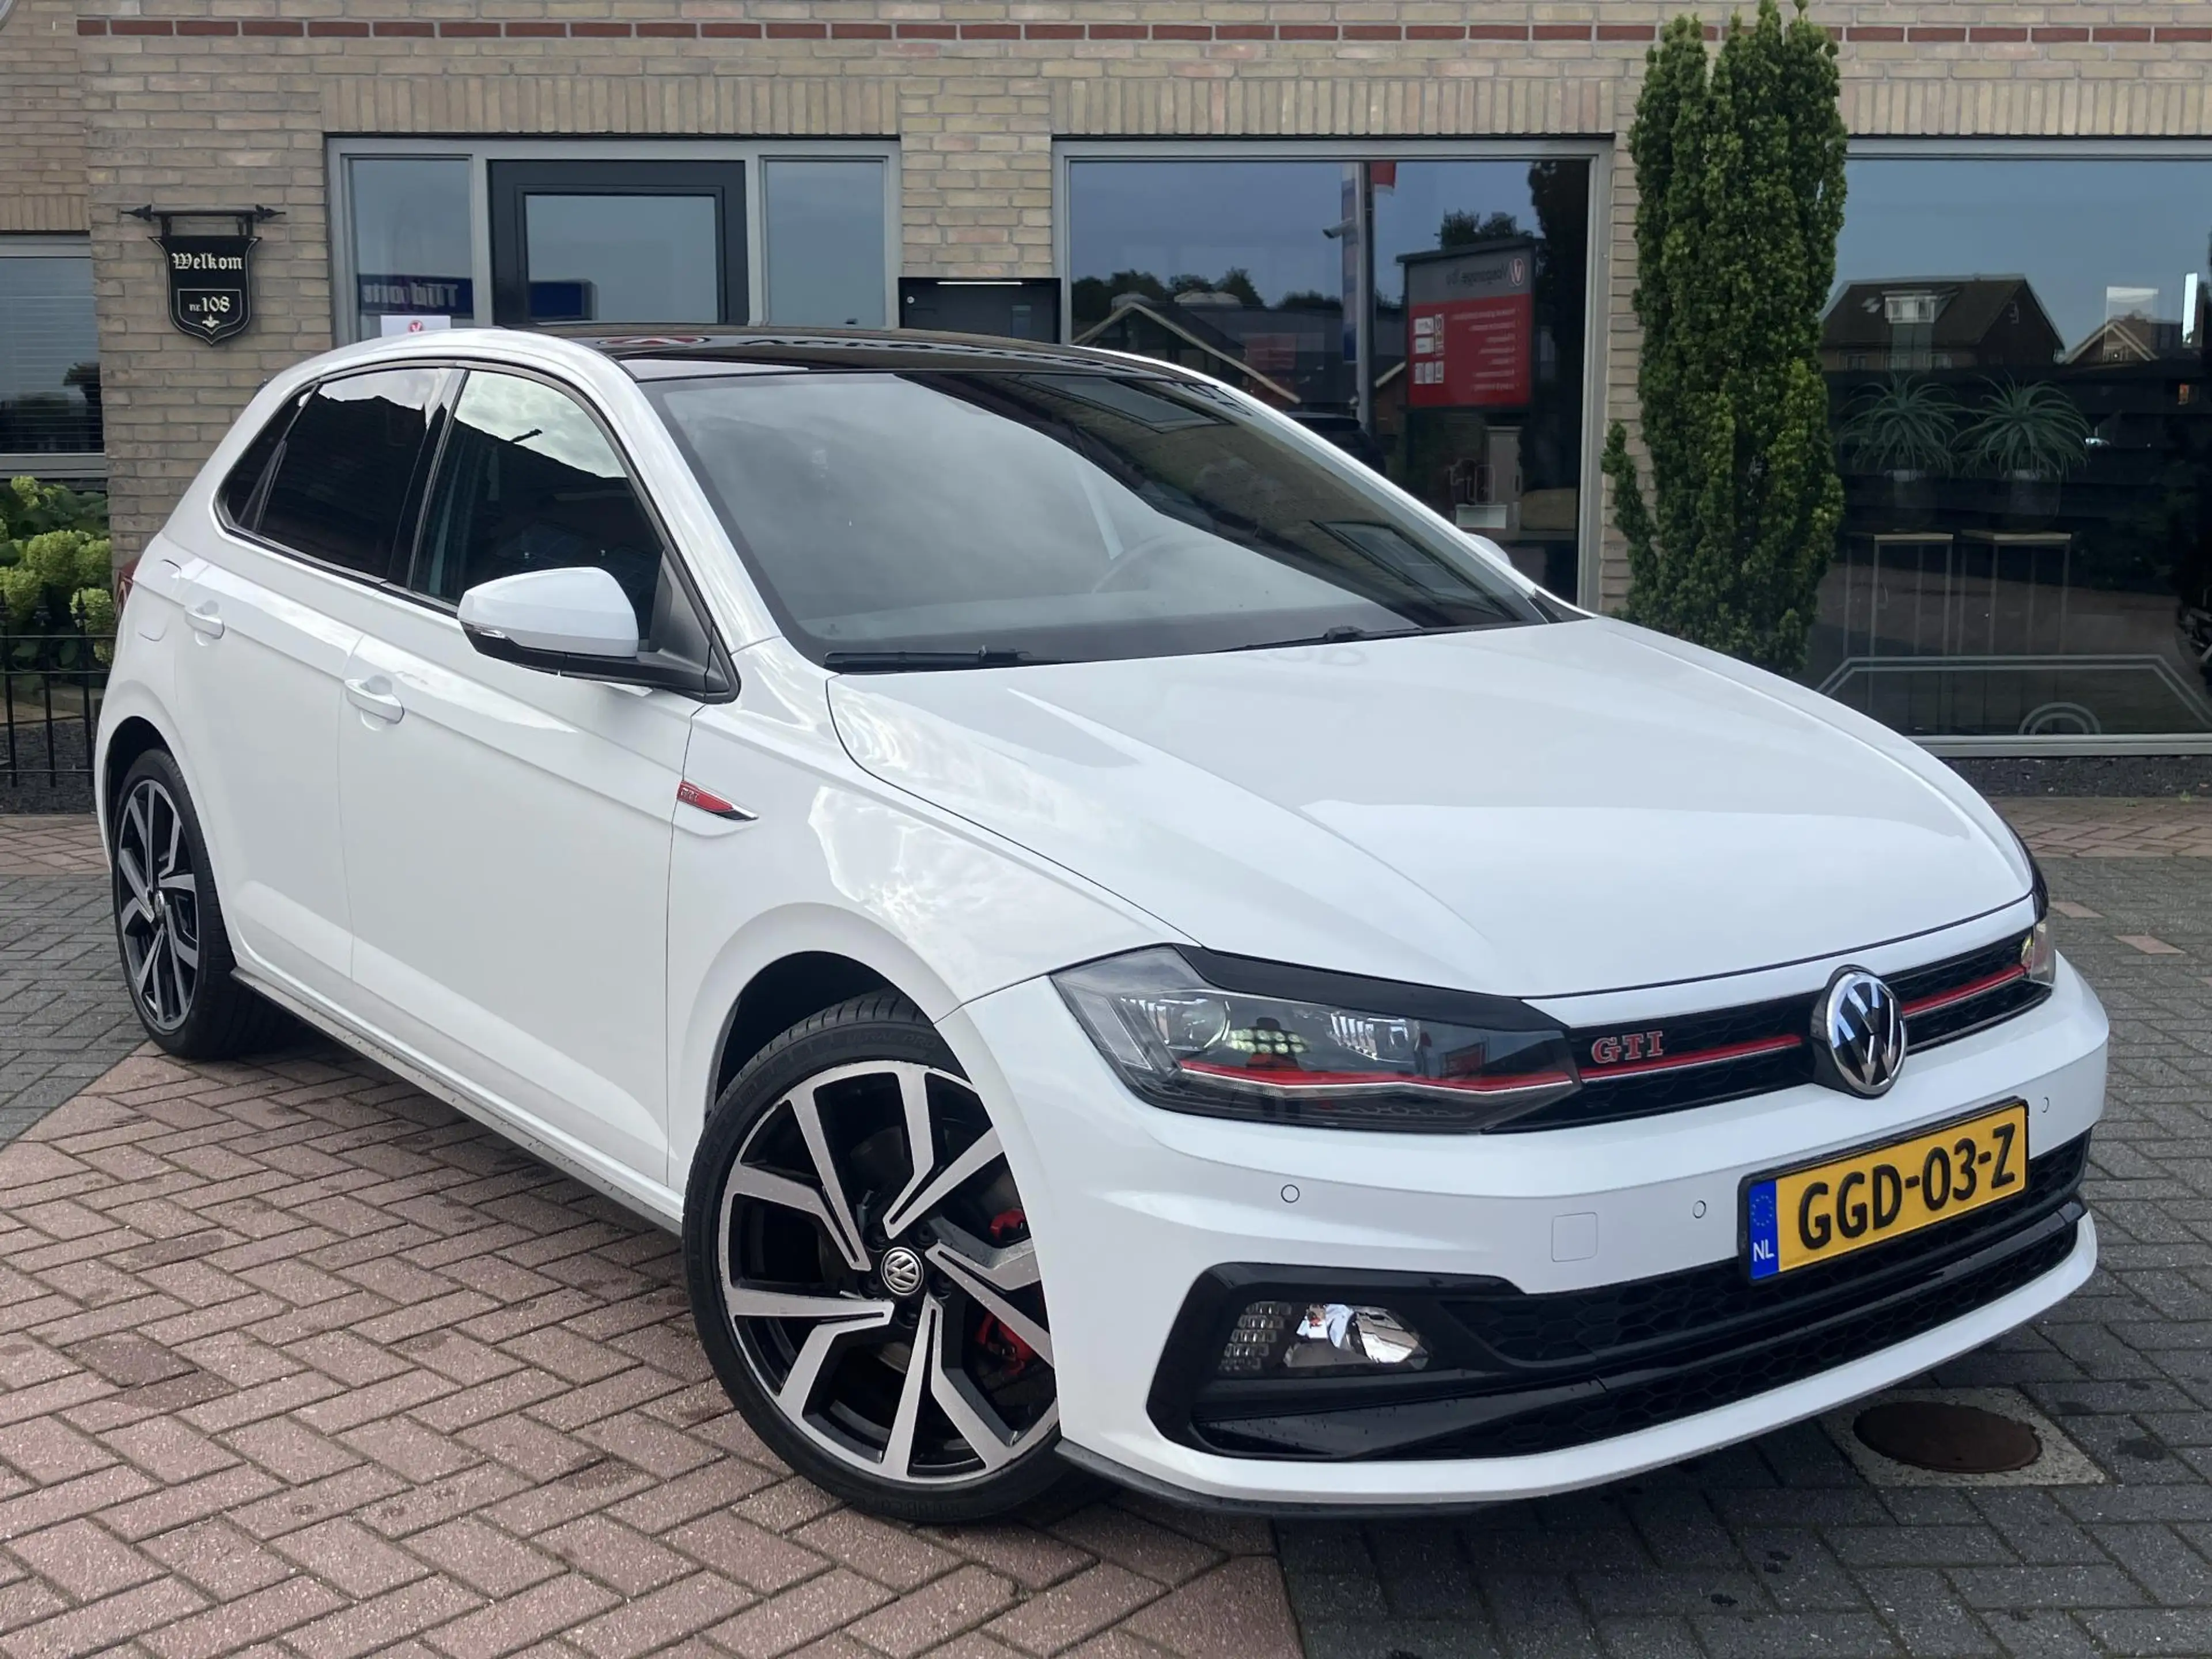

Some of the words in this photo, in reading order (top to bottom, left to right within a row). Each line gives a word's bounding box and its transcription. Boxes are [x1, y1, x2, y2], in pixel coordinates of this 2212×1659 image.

[172, 253, 242, 269] Welkom
[202, 296, 230, 312] 108
[1592, 1031, 1664, 1064] GTI
[1798, 1123, 2016, 1251] GGD-03-Z
[1753, 1238, 1774, 1262] NL
